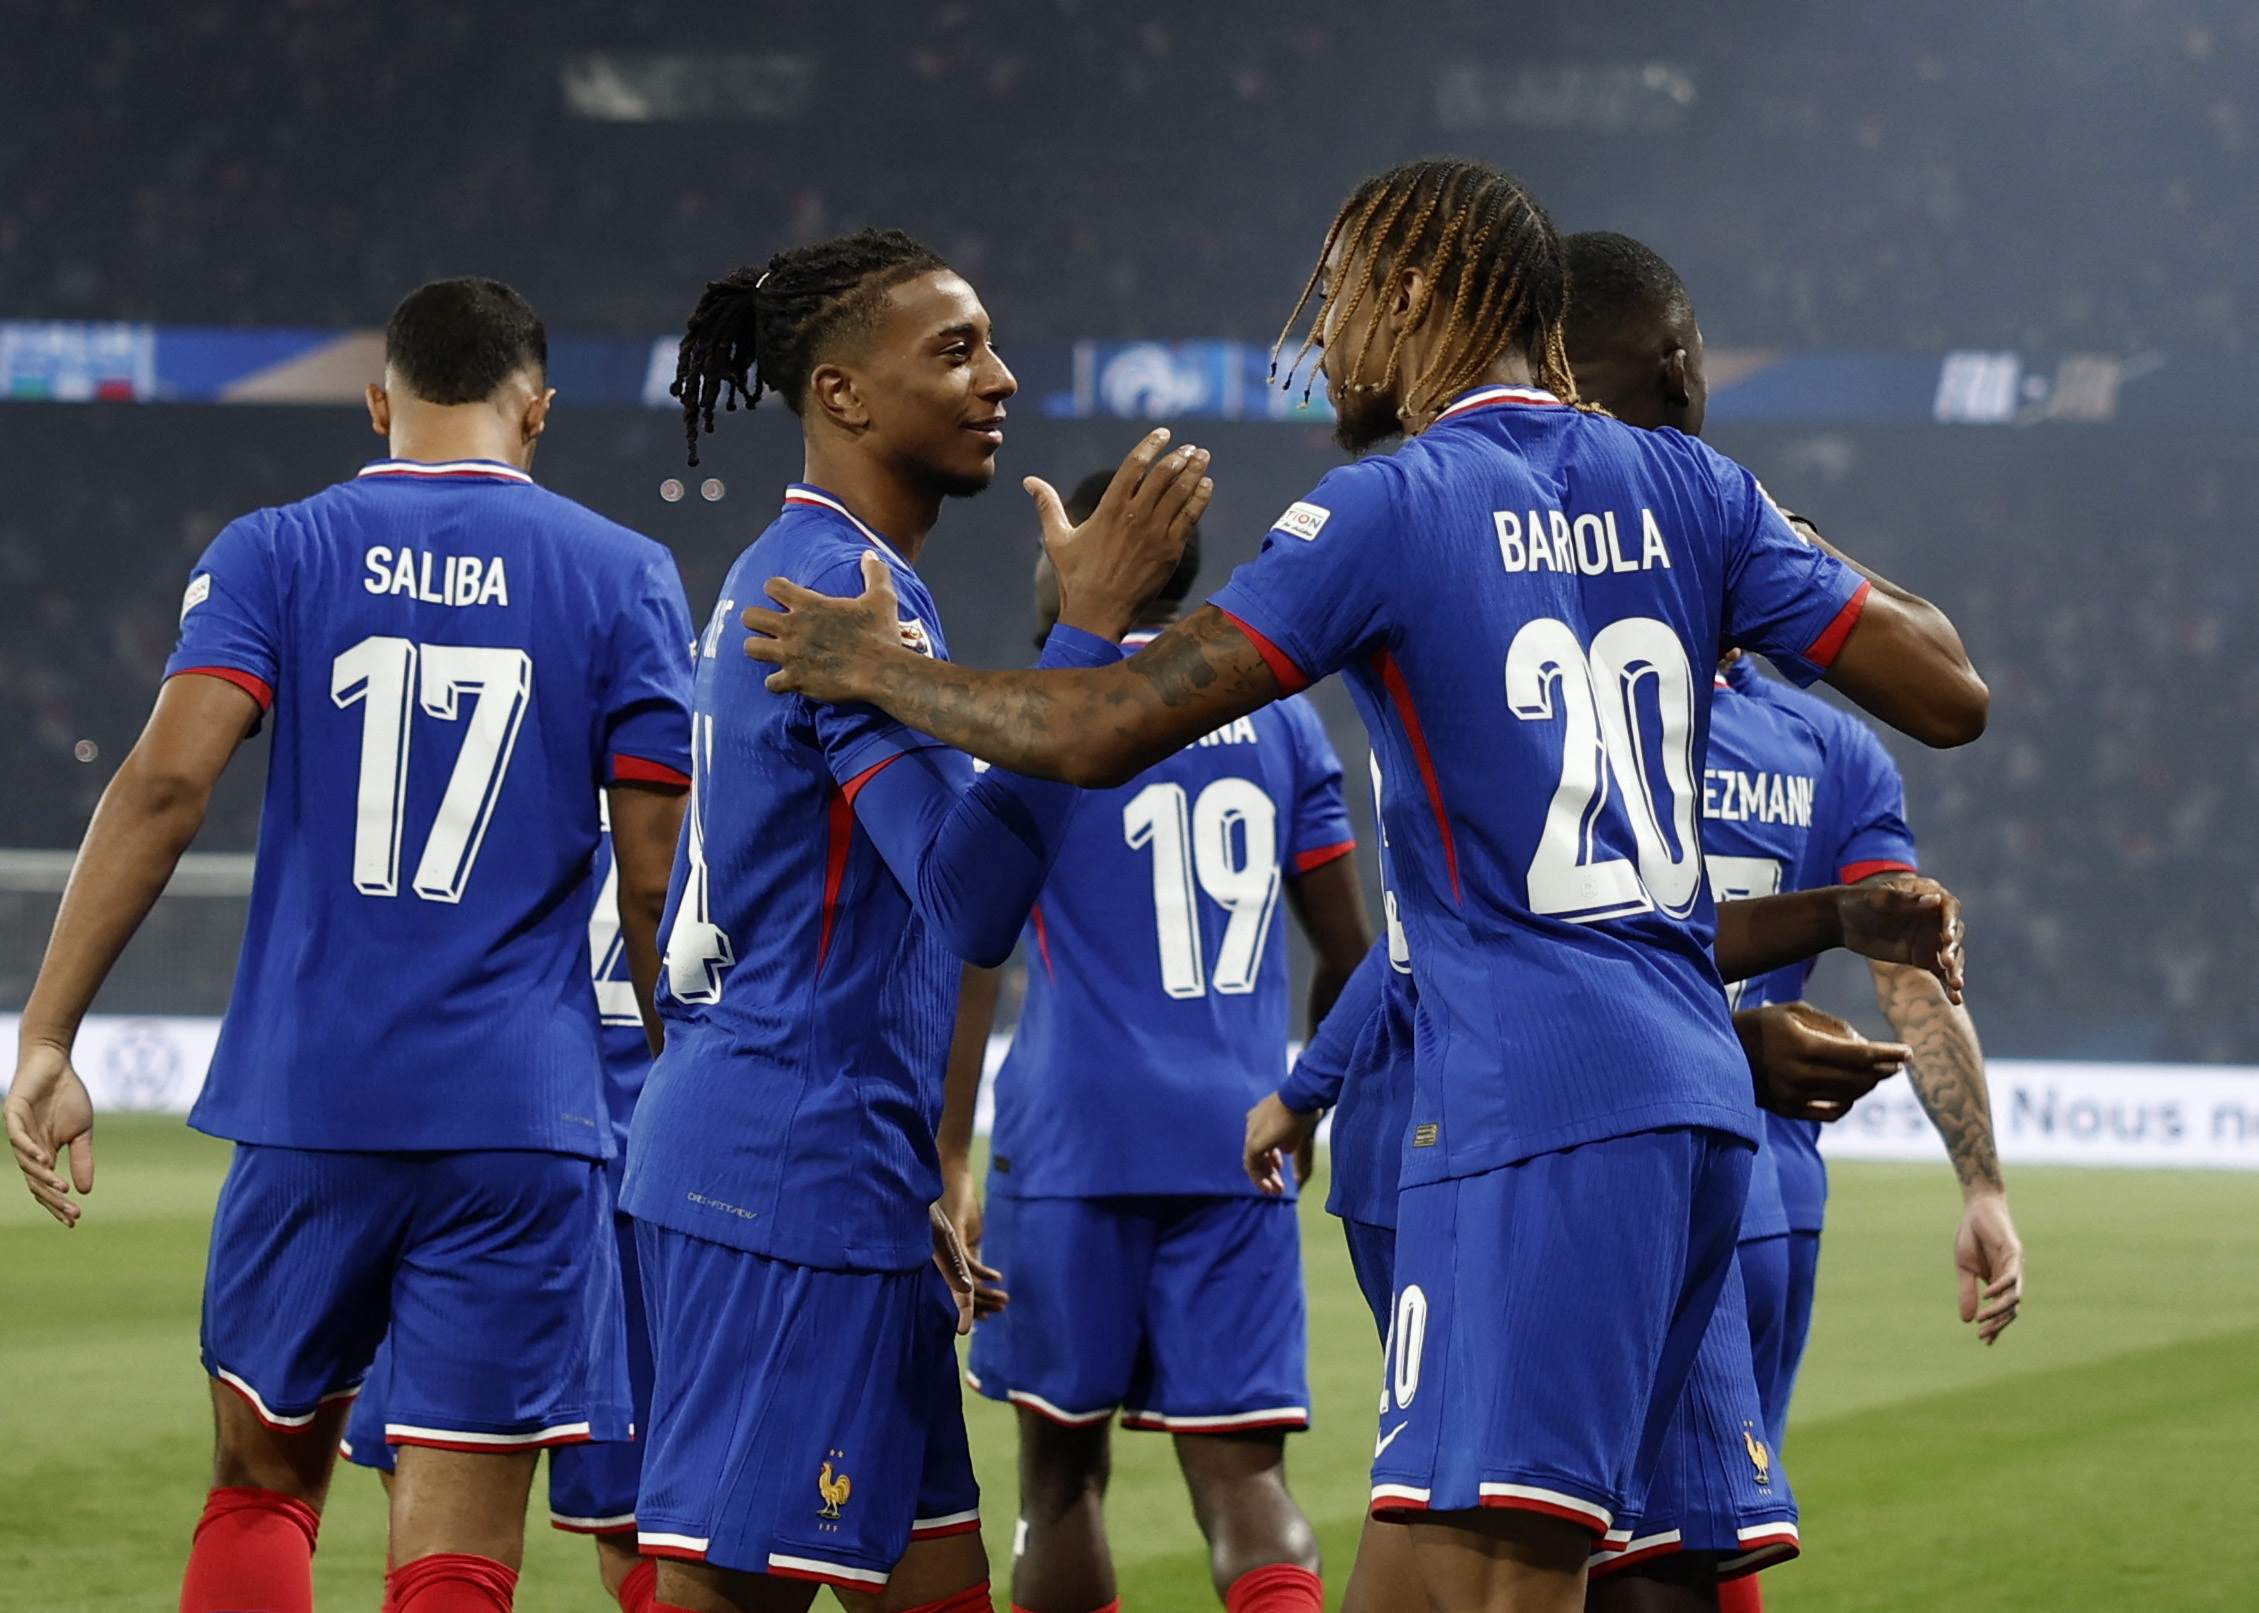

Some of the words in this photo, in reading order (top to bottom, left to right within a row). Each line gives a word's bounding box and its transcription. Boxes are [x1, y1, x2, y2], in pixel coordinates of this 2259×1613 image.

[364, 545, 509, 608] SALIBA
[330, 635, 533, 905] 17
[1505, 617, 1703, 924] 20
[1702, 768, 1815, 829] EZMANN
[1123, 777, 1282, 1000] 19
[2010, 1086, 2184, 1140] Nous
[2210, 1103, 2259, 1143] n
